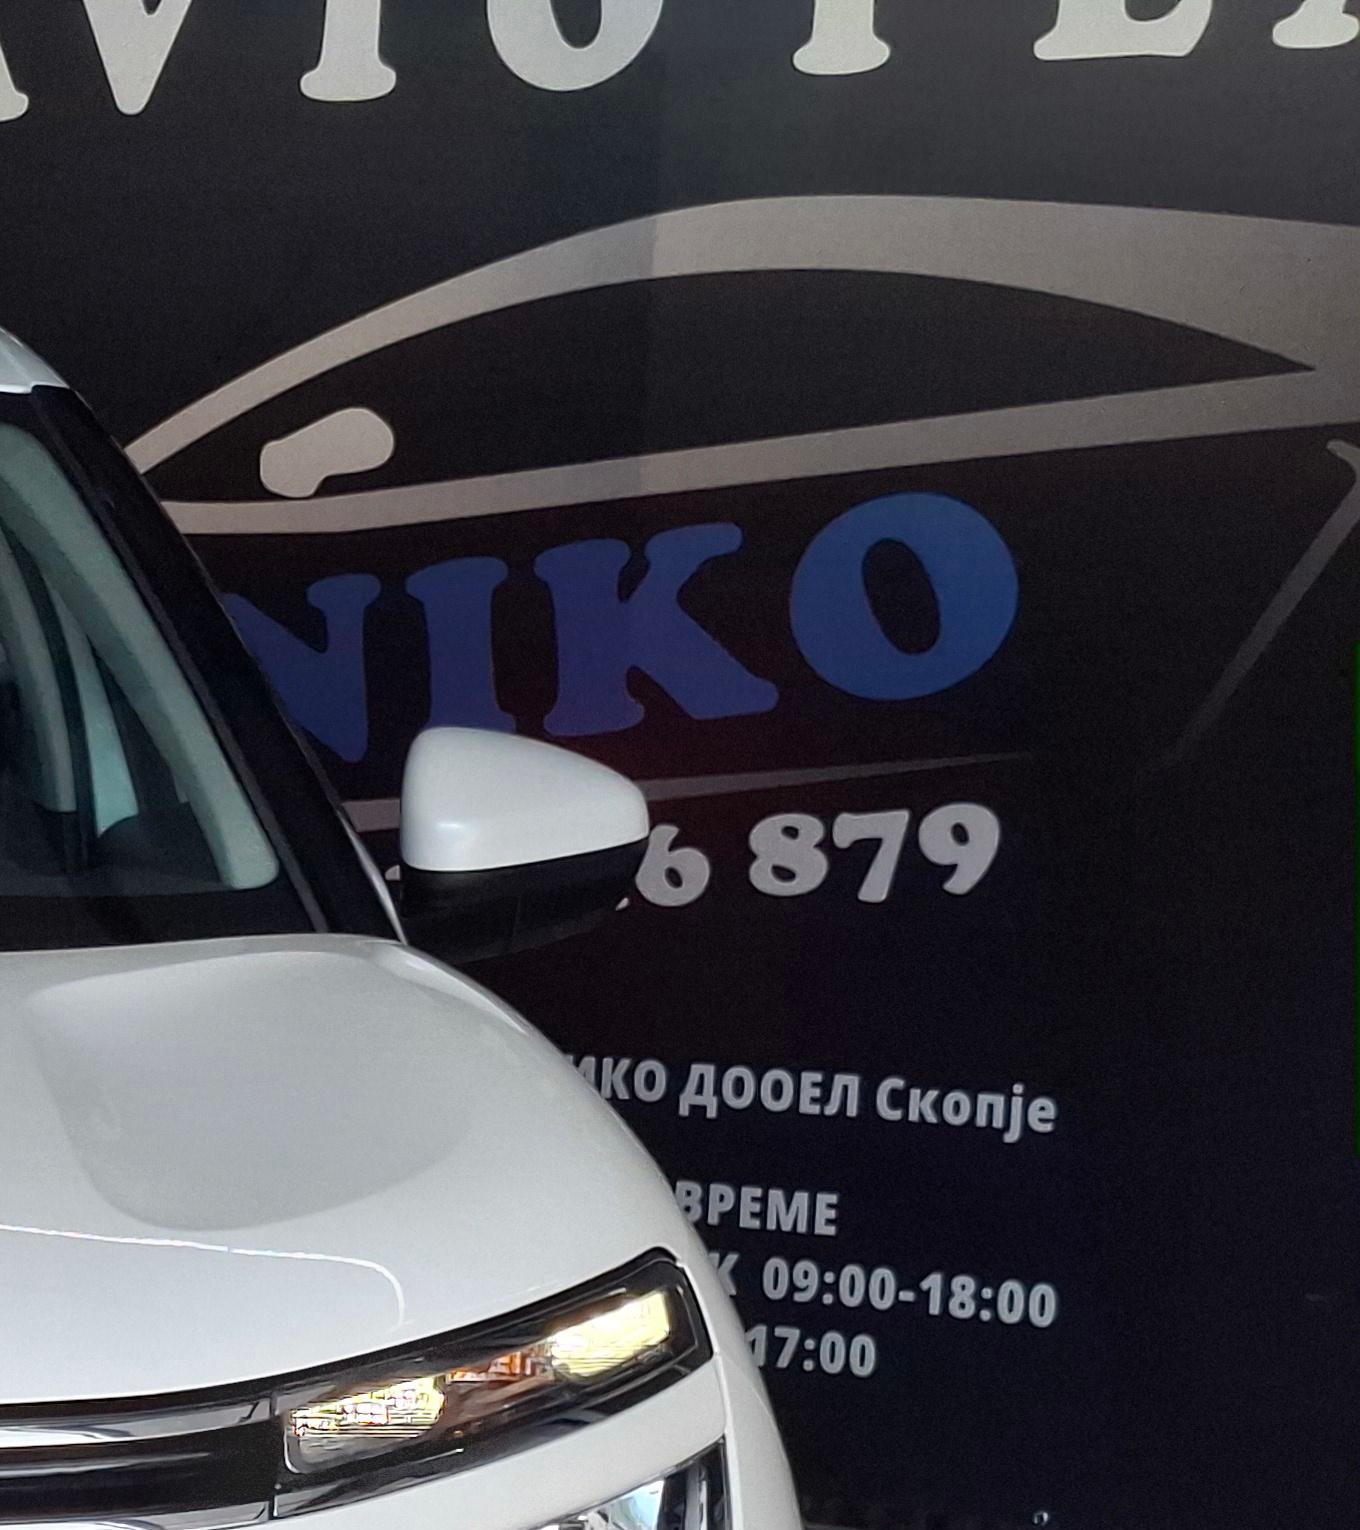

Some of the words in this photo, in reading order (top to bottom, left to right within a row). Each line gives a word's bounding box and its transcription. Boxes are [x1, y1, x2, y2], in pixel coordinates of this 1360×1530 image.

[222, 491, 1018, 762] NIKO
[748, 804, 1000, 902] 879
[679, 1064, 860, 1119] ДООЕЛ
[876, 1077, 1058, 1143] Скопје
[676, 1181, 840, 1237] ВРЕМЕ
[762, 1257, 1058, 1328] 09:00-18:00
